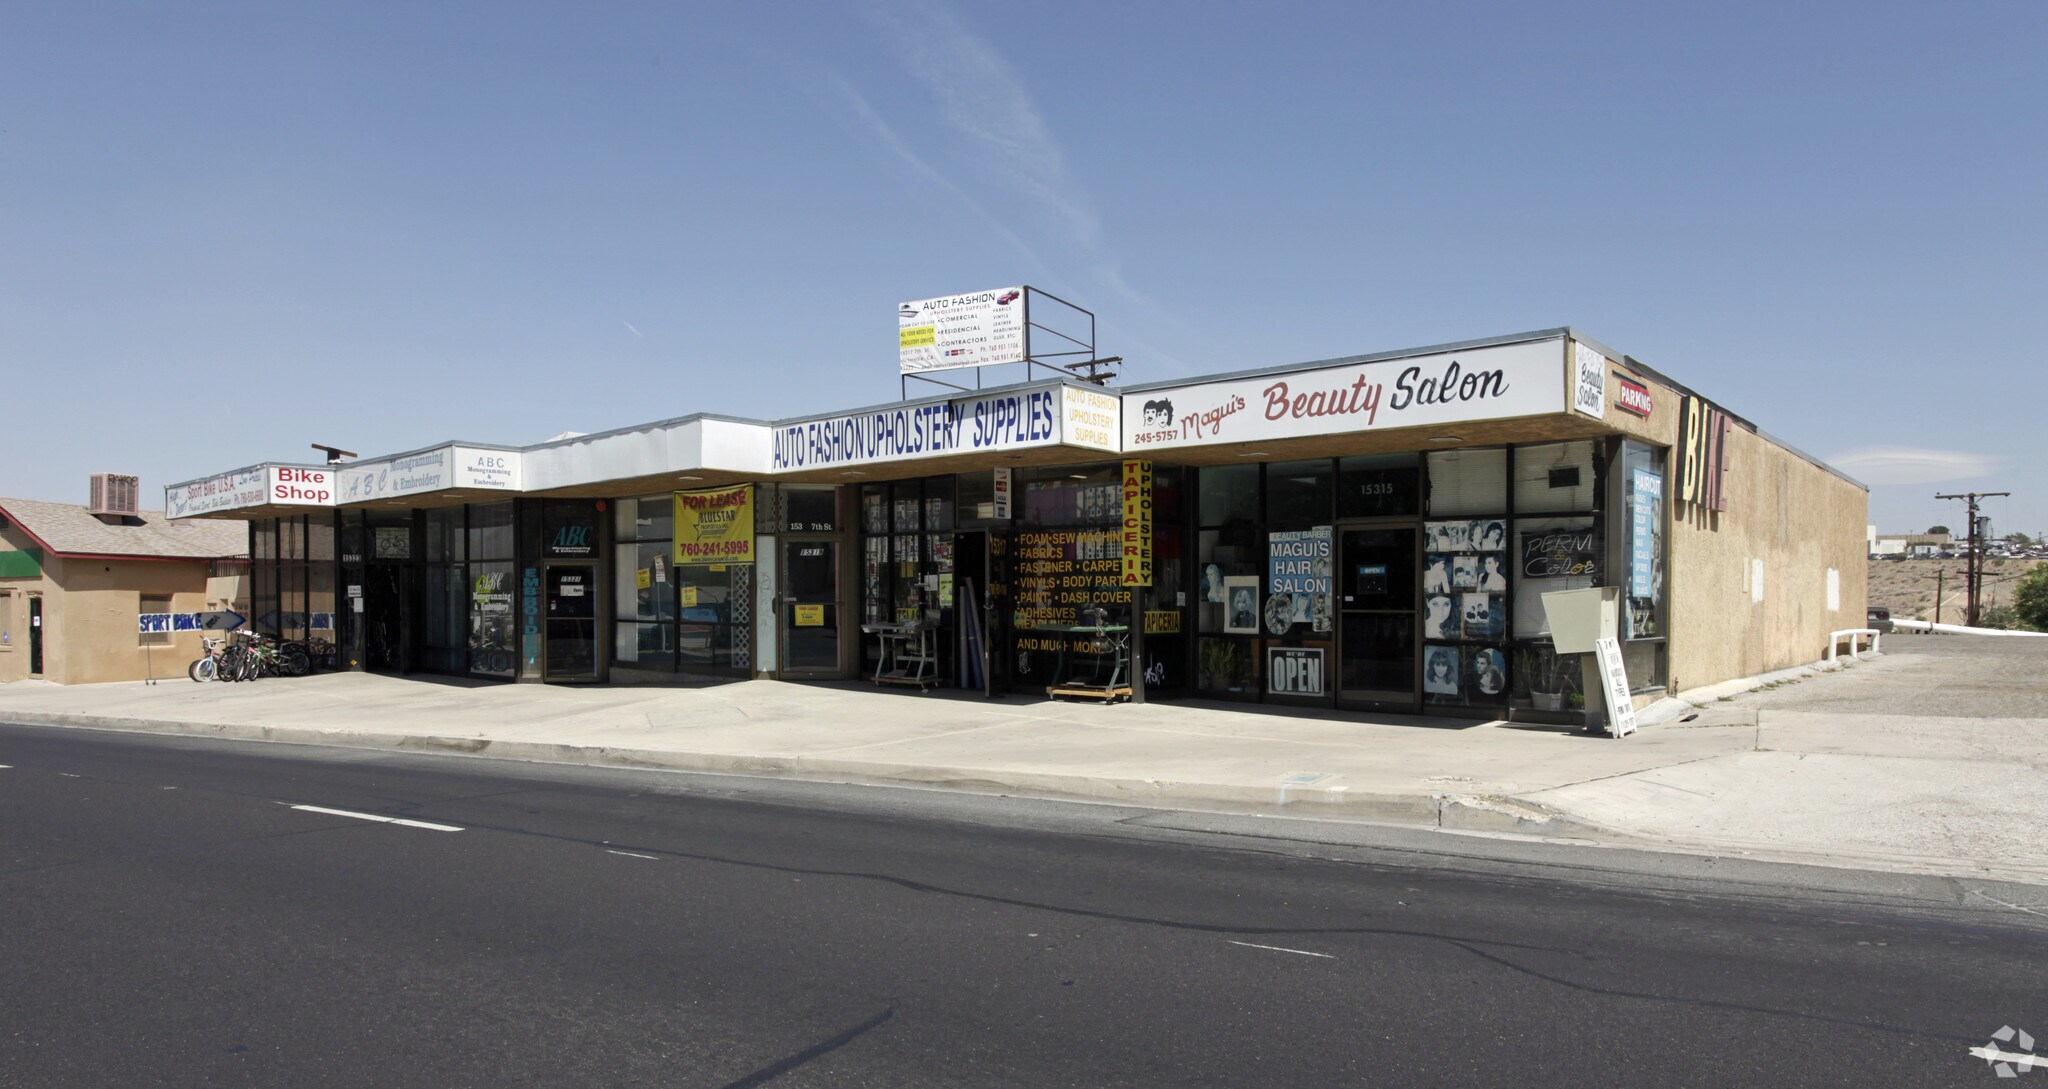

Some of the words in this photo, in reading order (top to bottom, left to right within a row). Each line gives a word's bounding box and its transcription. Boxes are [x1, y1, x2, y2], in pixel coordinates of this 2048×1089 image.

[923, 300, 949, 311] AUTO
[952, 292, 996, 307] FASHION
[930, 307, 964, 316] UPHOLSTERY
[966, 304, 990, 312] SUPPLIES
[941, 314, 978, 323] COMERCIAL
[940, 326, 980, 335] RESIDENCIAL
[941, 336, 988, 346] CONTRACTORS
[1581, 362, 1603, 395] Beauty
[1066, 389, 1086, 404] AUTO
[1088, 393, 1117, 412] FASHION
[1181, 394, 1246, 440] Magui's
[1263, 374, 1382, 426] Beauty
[1390, 360, 1510, 410] Salon
[1577, 386, 1600, 412] Salon
[1069, 408, 1114, 429] UPHOLSTERY
[774, 426, 804, 470] AUTO
[810, 416, 864, 464] FASHION
[867, 403, 965, 458] UPHOLSTERY
[974, 391, 1053, 448] SUPPLIES
[1075, 427, 1108, 446] SUPPLIES
[1134, 430, 1178, 444] 245-5757
[1677, 396, 1732, 512] BIKE
[390, 452, 444, 473] Monogramming
[278, 468, 324, 483] Bike
[467, 466, 511, 476] Monogramming
[400, 473, 441, 490] Embroidery
[474, 478, 505, 488] Embroidery
[1361, 484, 1393, 494] 15315
[1634, 474, 1661, 496] HAIRCUT
[188, 485, 202, 501] Sport
[204, 482, 216, 496] Bike
[275, 485, 330, 503] Shop
[682, 495, 708, 510] FOR
[709, 490, 747, 508] LEASE
[700, 510, 736, 524] BLUESTAR
[1124, 463, 1140, 584] TAPICERIA
[1140, 462, 1151, 583] UPHOLSTERY
[553, 526, 592, 546] ABC
[1020, 534, 1050, 545] FOAM
[1052, 532, 1076, 544] SEW
[1078, 532, 1123, 544] MACHIN
[1274, 532, 1300, 541] BEAUTY
[1302, 530, 1332, 539] BARBER
[680, 540, 749, 556] 760-241-5995
[1020, 548, 1063, 559] FABRICS
[1270, 542, 1330, 557] MAGUI'S
[1526, 534, 1592, 558] PERM
[1020, 561, 1072, 573] FASTENER
[1082, 560, 1123, 572] CARPE
[1275, 560, 1312, 575] HAIR
[1020, 577, 1056, 589] VINYLS
[1062, 576, 1092, 587] BODY
[1095, 576, 1124, 587] PART
[1274, 578, 1326, 593] SALON
[472, 592, 511, 603] Monogramming
[1020, 592, 1048, 604] PAINT
[1062, 592, 1090, 604] DASH
[1093, 592, 1132, 603] COVER
[1020, 608, 1076, 619] ADHESIVES
[140, 614, 172, 632] SPORT
[174, 613, 202, 630] BIKE
[1018, 638, 1038, 650] AND
[1273, 656, 1321, 693] OPEN
